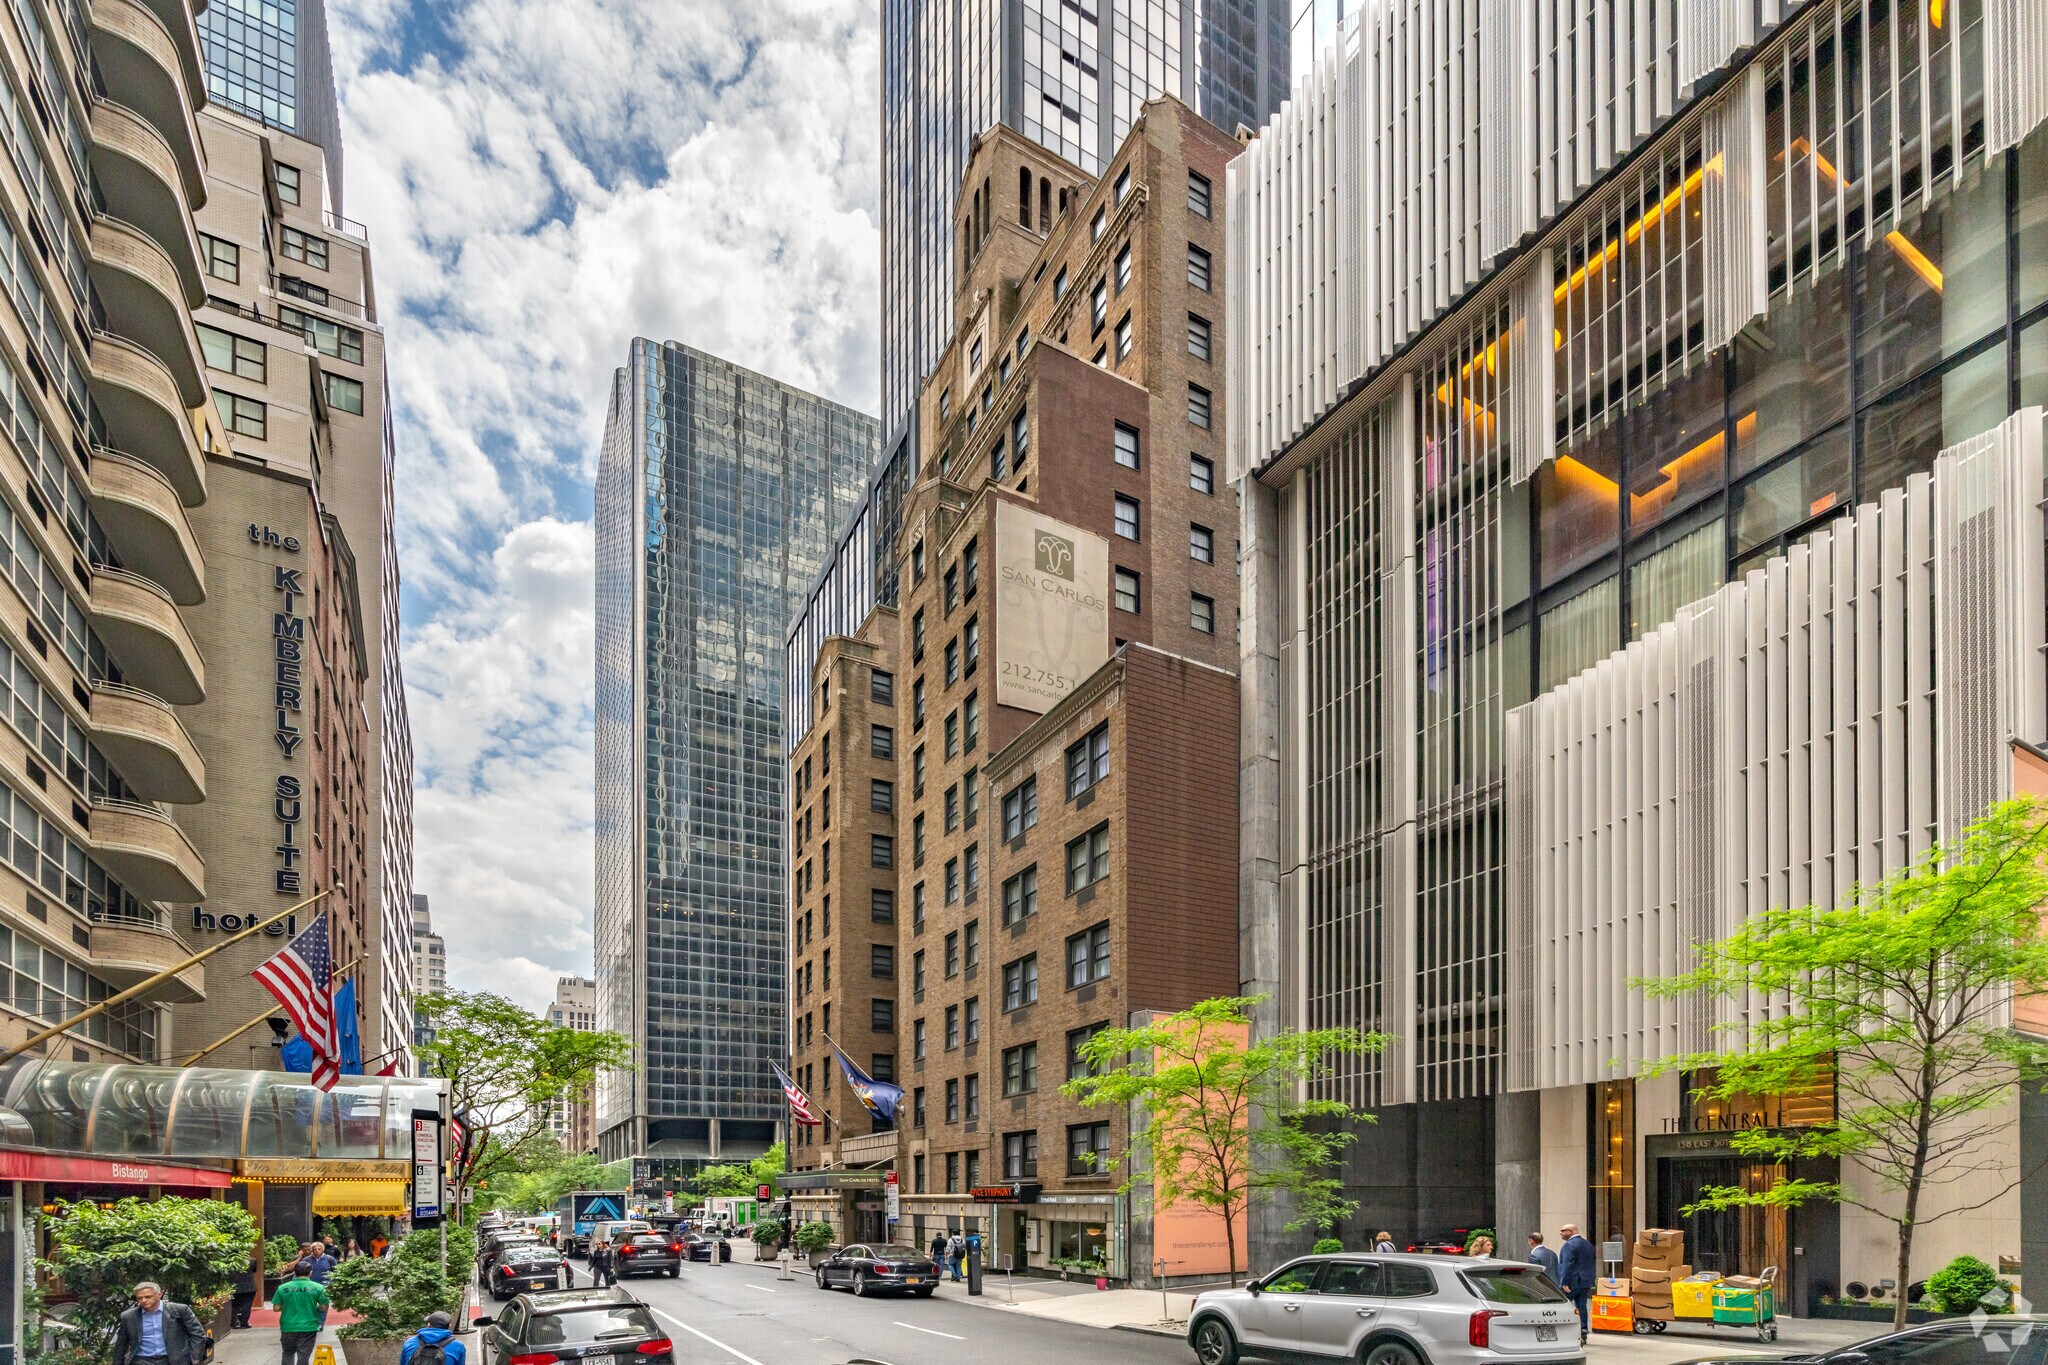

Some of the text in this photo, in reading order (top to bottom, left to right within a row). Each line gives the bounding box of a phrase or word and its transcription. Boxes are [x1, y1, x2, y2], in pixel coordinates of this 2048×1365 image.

[248, 522, 301, 551] the
[1001, 566, 1105, 611] SAN CARLOS
[272, 564, 305, 894] KIMBERLY SUITE
[192, 906, 298, 937] hotel
[1694, 1109, 1788, 1132] CENTRALE
[112, 1163, 148, 1181] Bistango
